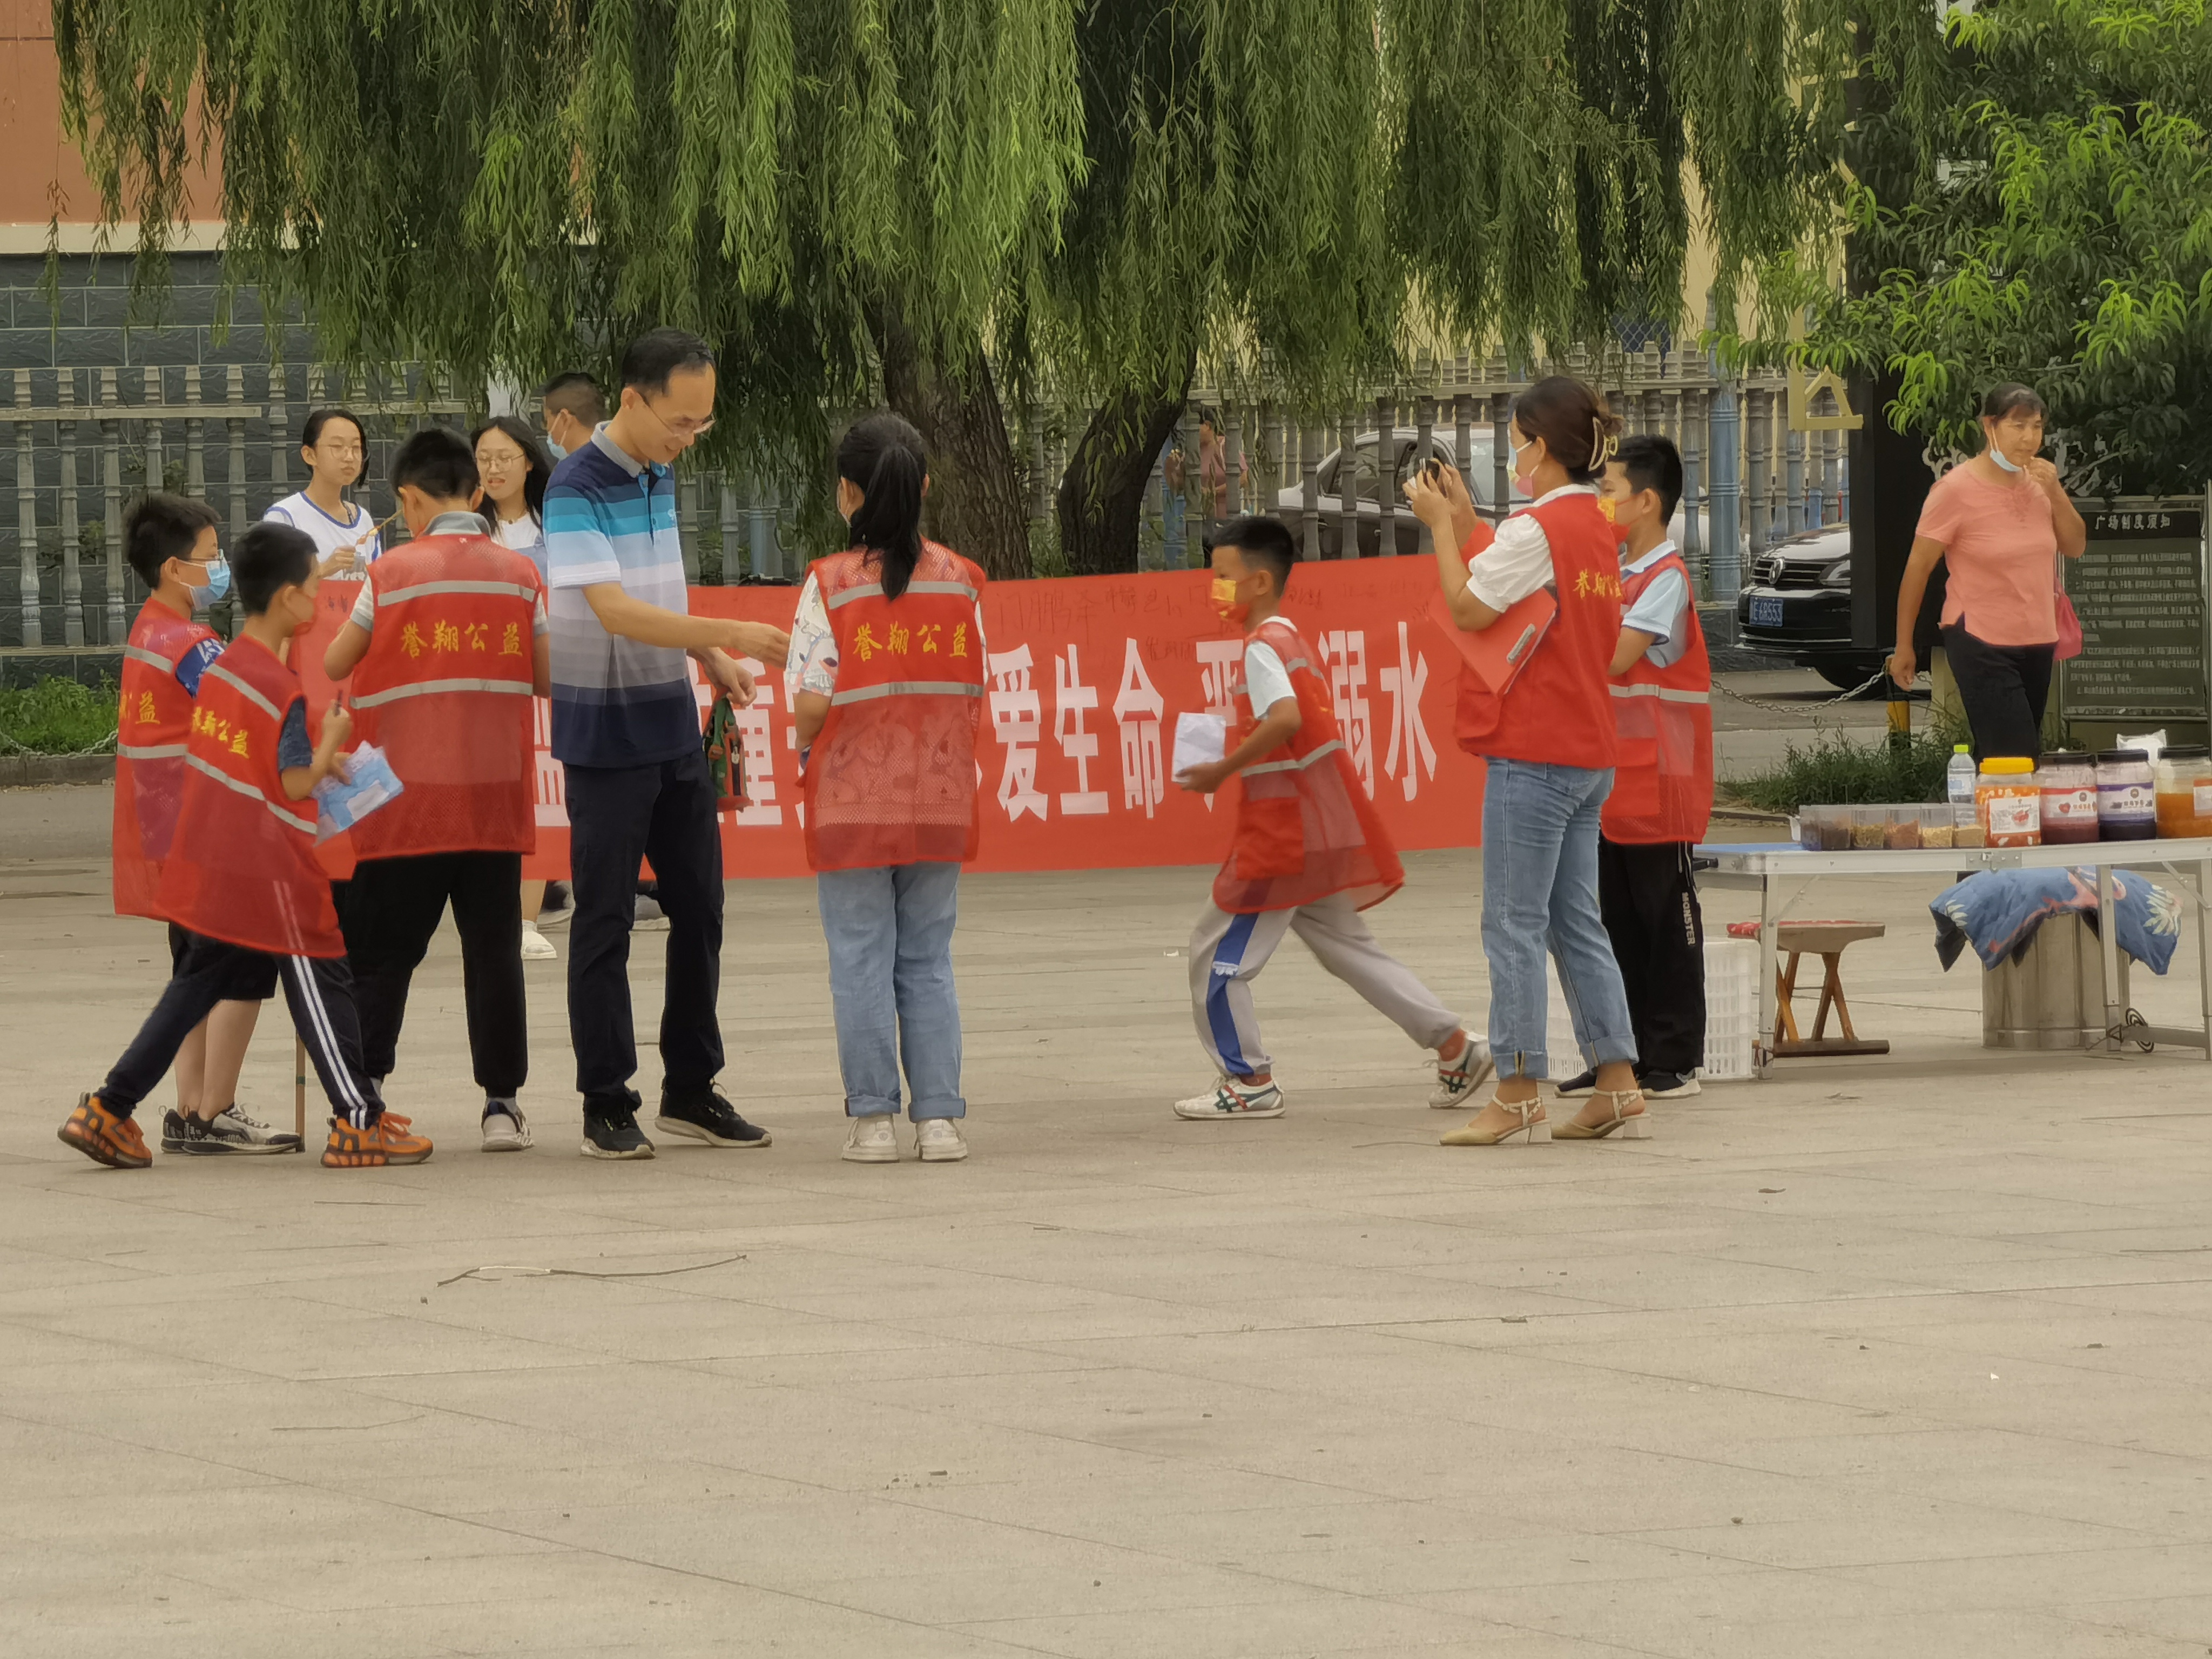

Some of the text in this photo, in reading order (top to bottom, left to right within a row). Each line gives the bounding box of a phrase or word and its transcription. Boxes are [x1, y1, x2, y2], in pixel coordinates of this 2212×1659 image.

[400, 619, 523, 658] 誉翔公益
[853, 621, 968, 662] 誉翔公益
[1682, 892, 1696, 946] MONSTER
